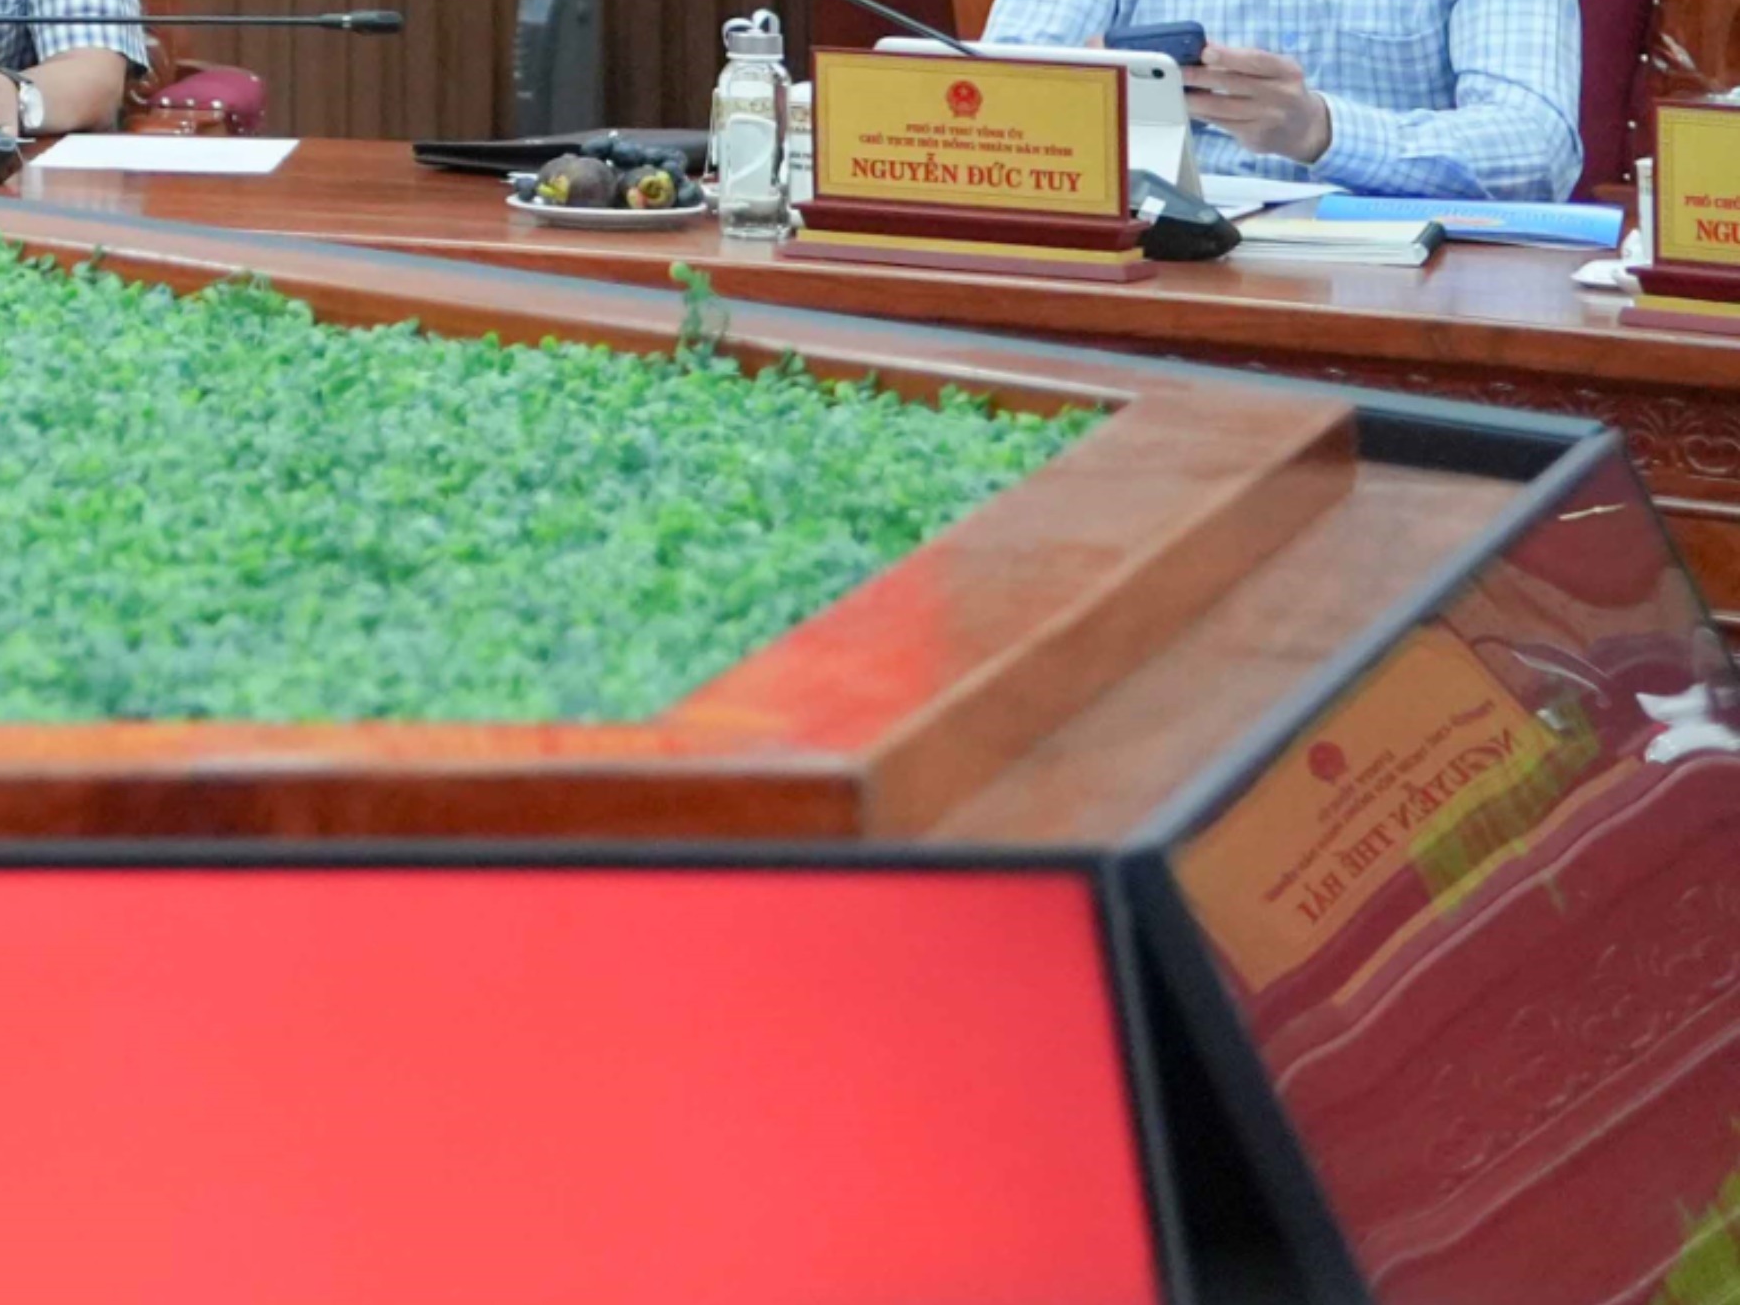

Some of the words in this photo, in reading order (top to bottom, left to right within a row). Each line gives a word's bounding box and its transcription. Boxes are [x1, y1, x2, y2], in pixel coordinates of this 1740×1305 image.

[851, 153, 959, 185] NGUYỄN
[966, 162, 1023, 189] ĐỨC
[1029, 169, 1082, 193] TUY
